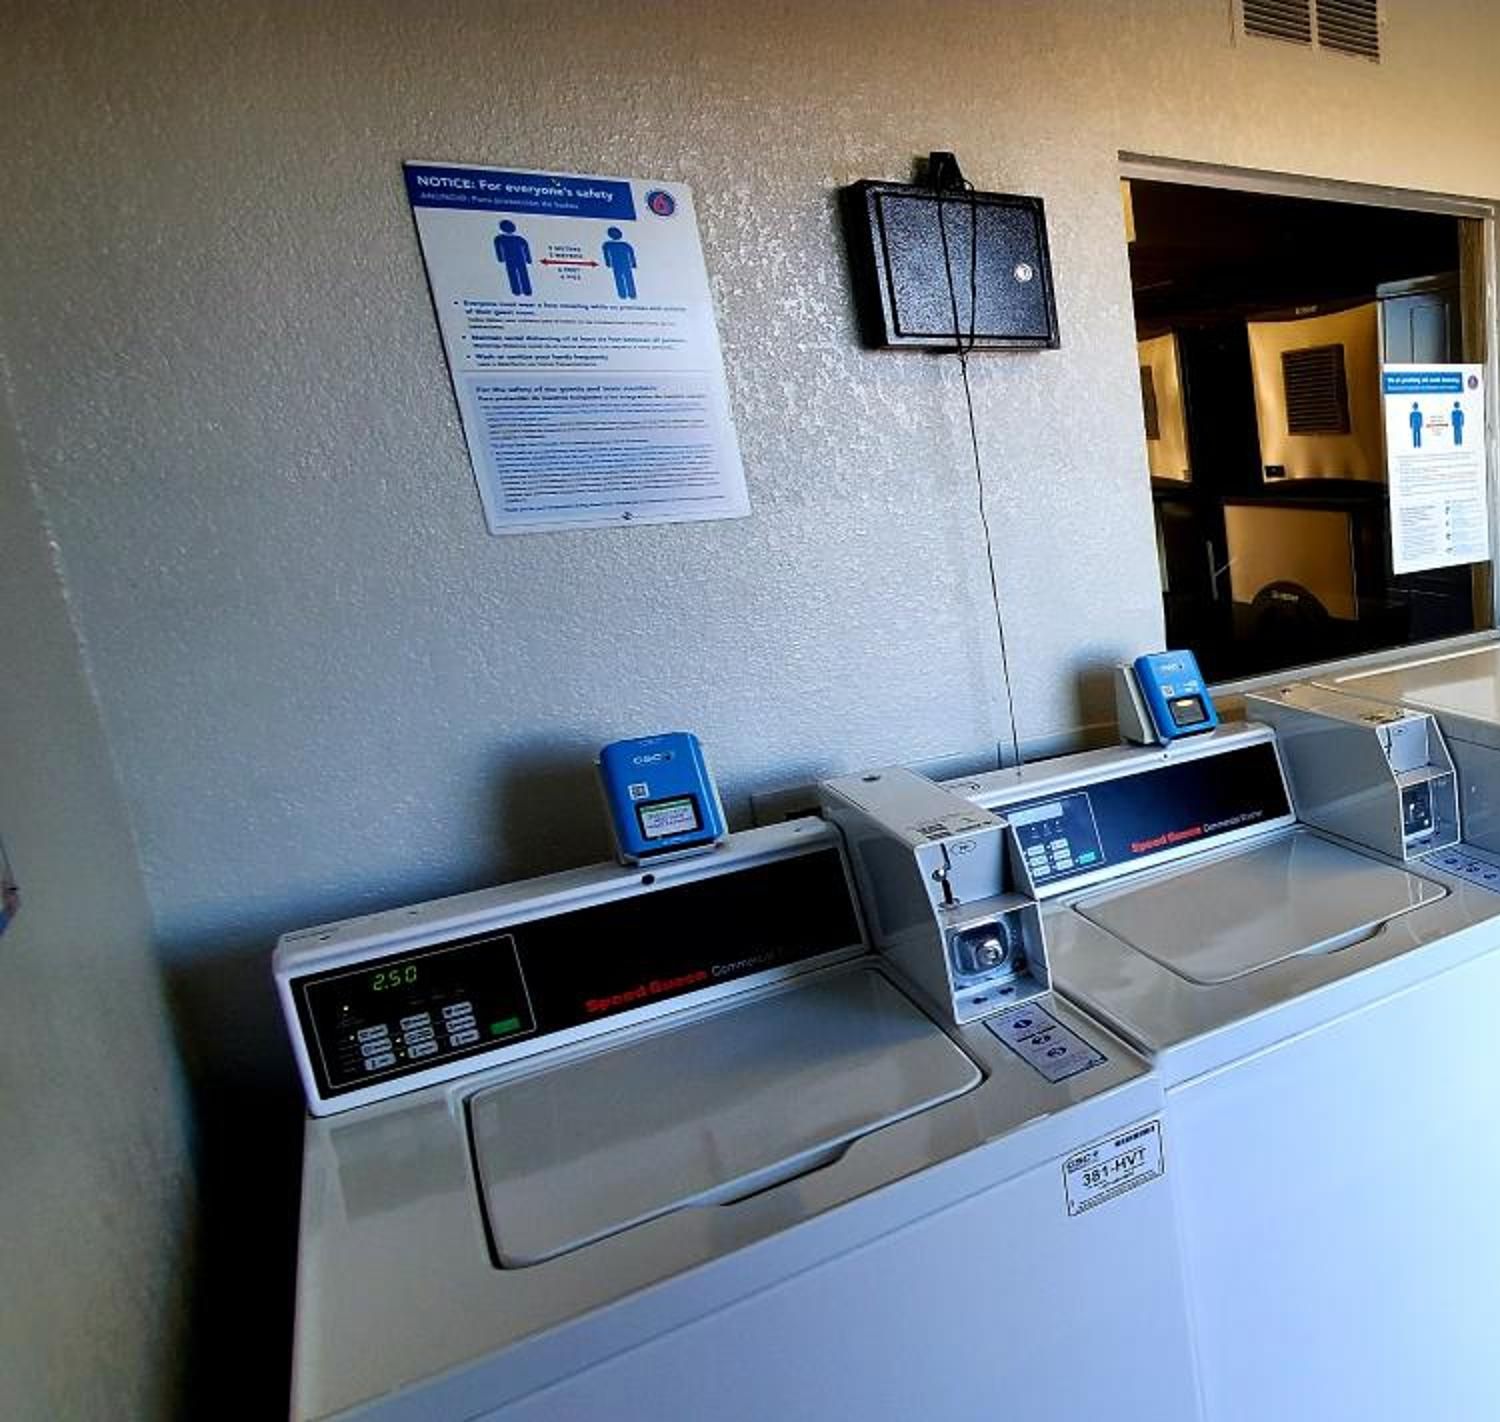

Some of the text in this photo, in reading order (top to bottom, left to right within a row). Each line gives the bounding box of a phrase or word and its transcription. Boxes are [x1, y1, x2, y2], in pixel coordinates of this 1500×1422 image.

[416, 174, 614, 202] NOTICE: For everyone's safety
[1131, 833, 1167, 853] Speed
[373, 965, 417, 991] 2.50
[584, 985, 648, 1012] Speed
[650, 970, 708, 993] Queen
[1082, 1147, 1147, 1187] 381-HVT
